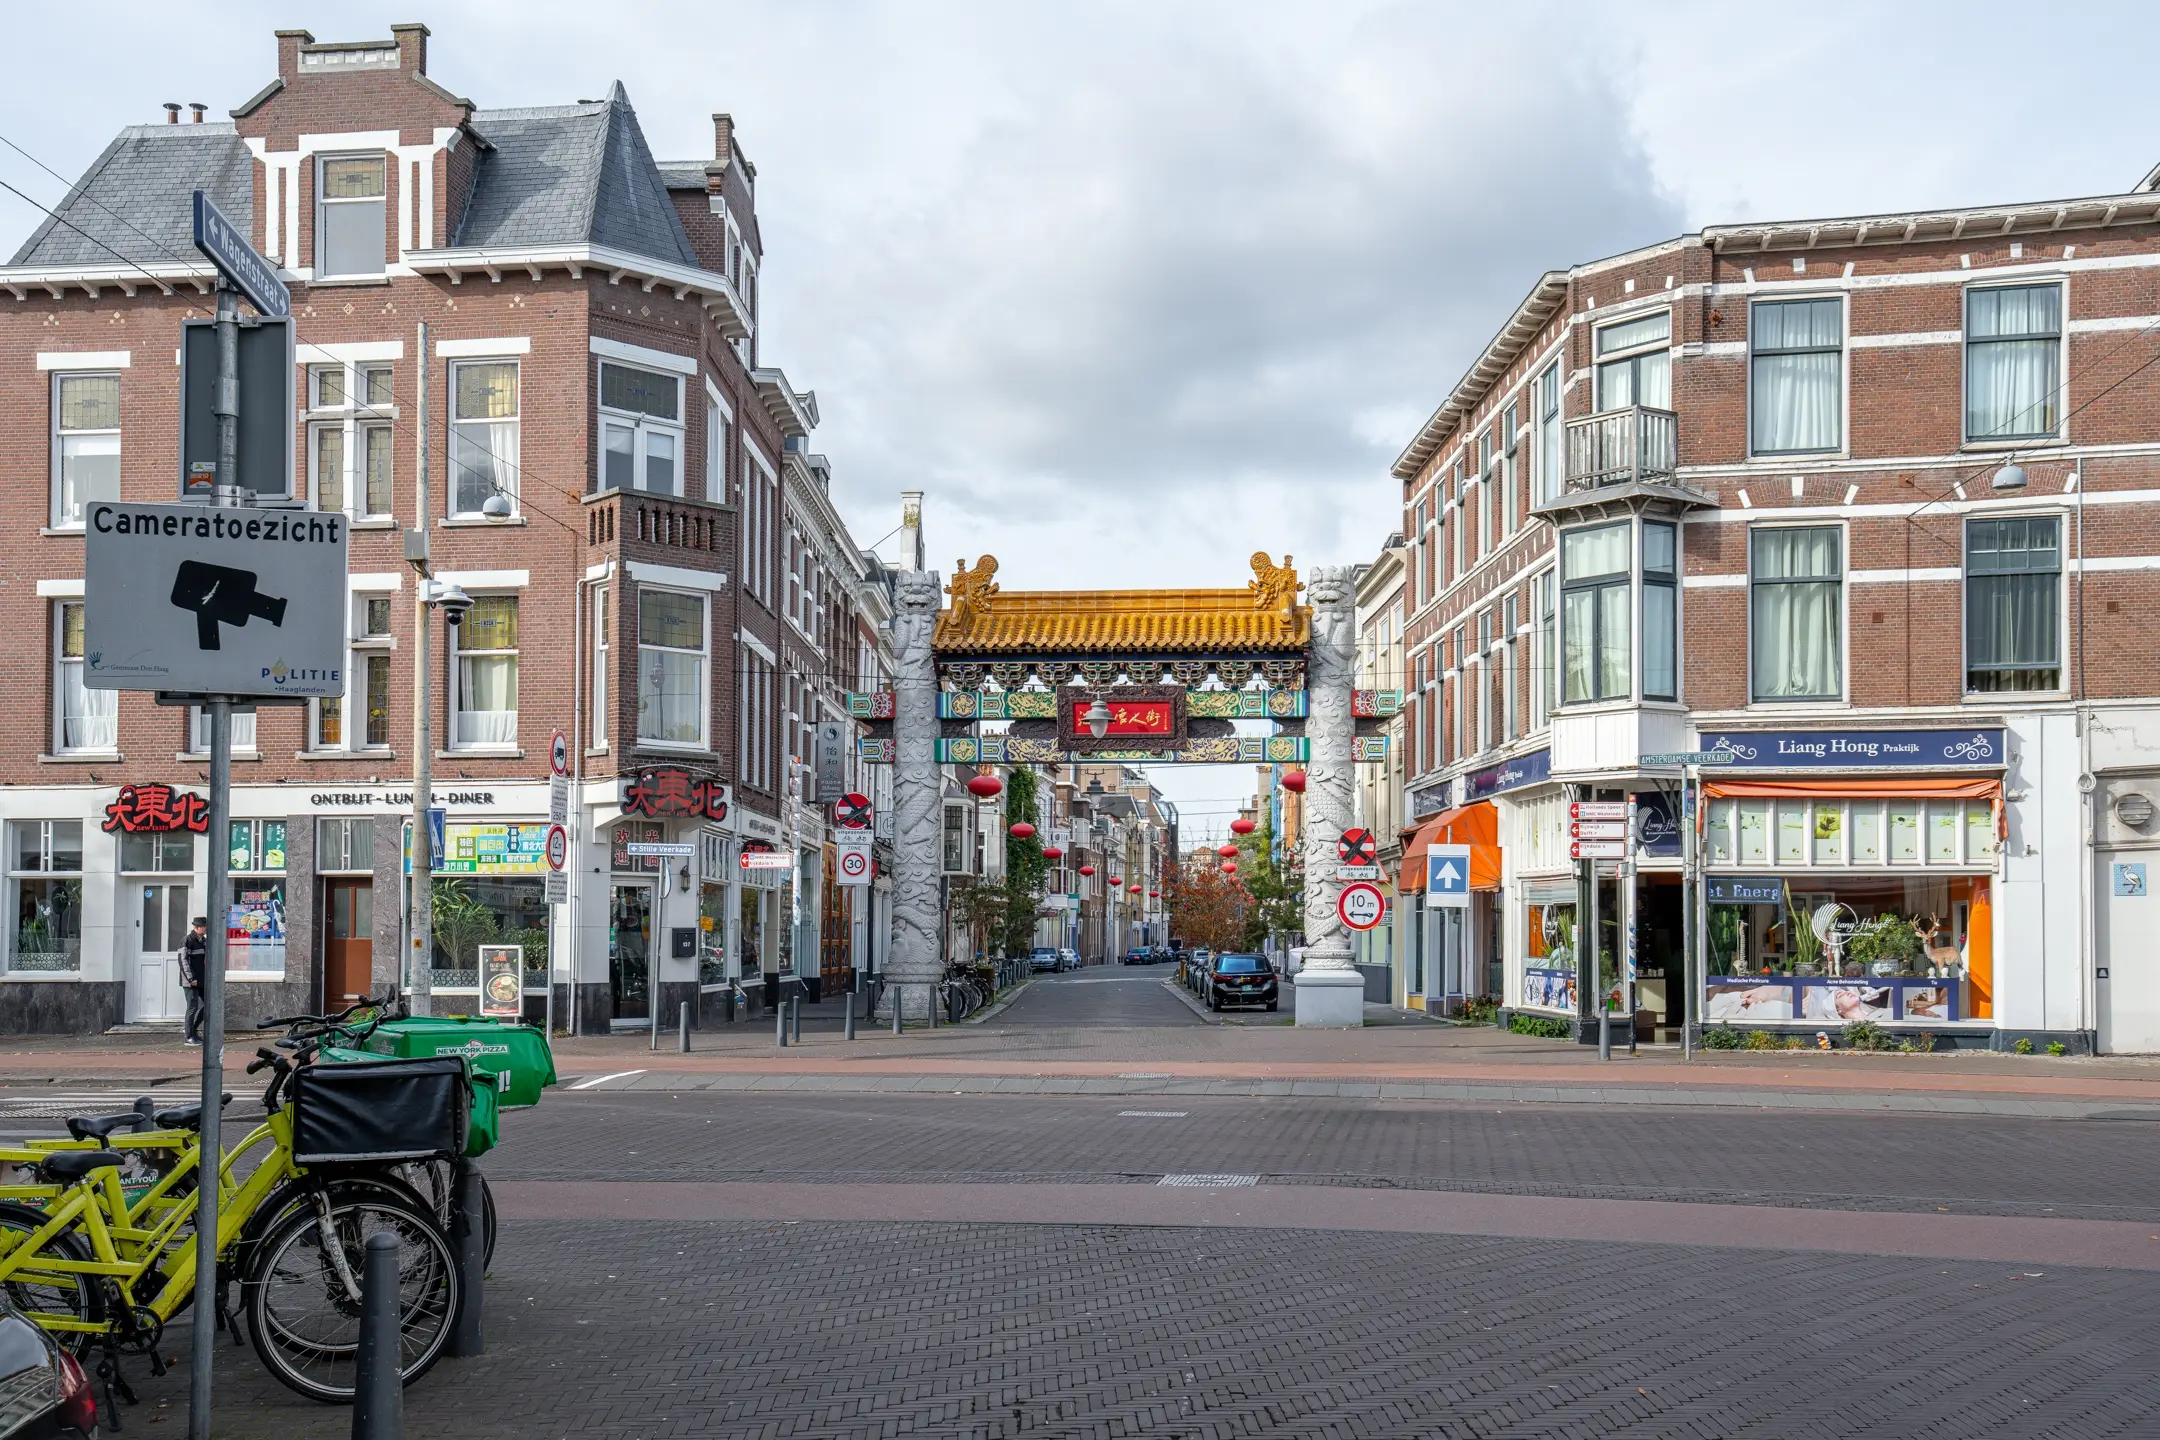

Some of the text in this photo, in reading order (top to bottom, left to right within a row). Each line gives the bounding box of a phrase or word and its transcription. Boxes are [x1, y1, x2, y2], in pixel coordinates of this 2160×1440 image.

[220, 222, 278, 308] Wagenstraat
[94, 506, 339, 544] Cameratoezicht
[154, 665, 169, 674] Haag
[278, 685, 326, 694] Haaglanden
[1778, 739, 1920, 757] Liang Hong Praktijk
[1641, 753, 1730, 764] AMSTERDAMSE VEERKADE
[310, 792, 495, 805] ONTBIJT LUN DINER
[103, 785, 209, 832] 大東北
[846, 859, 863, 869] 30
[1351, 894, 1365, 908] 10
[1830, 917, 1855, 933] Liang
[458, 1046, 482, 1054] YORK
[120, 1175, 158, 1185] ANT YOU!
